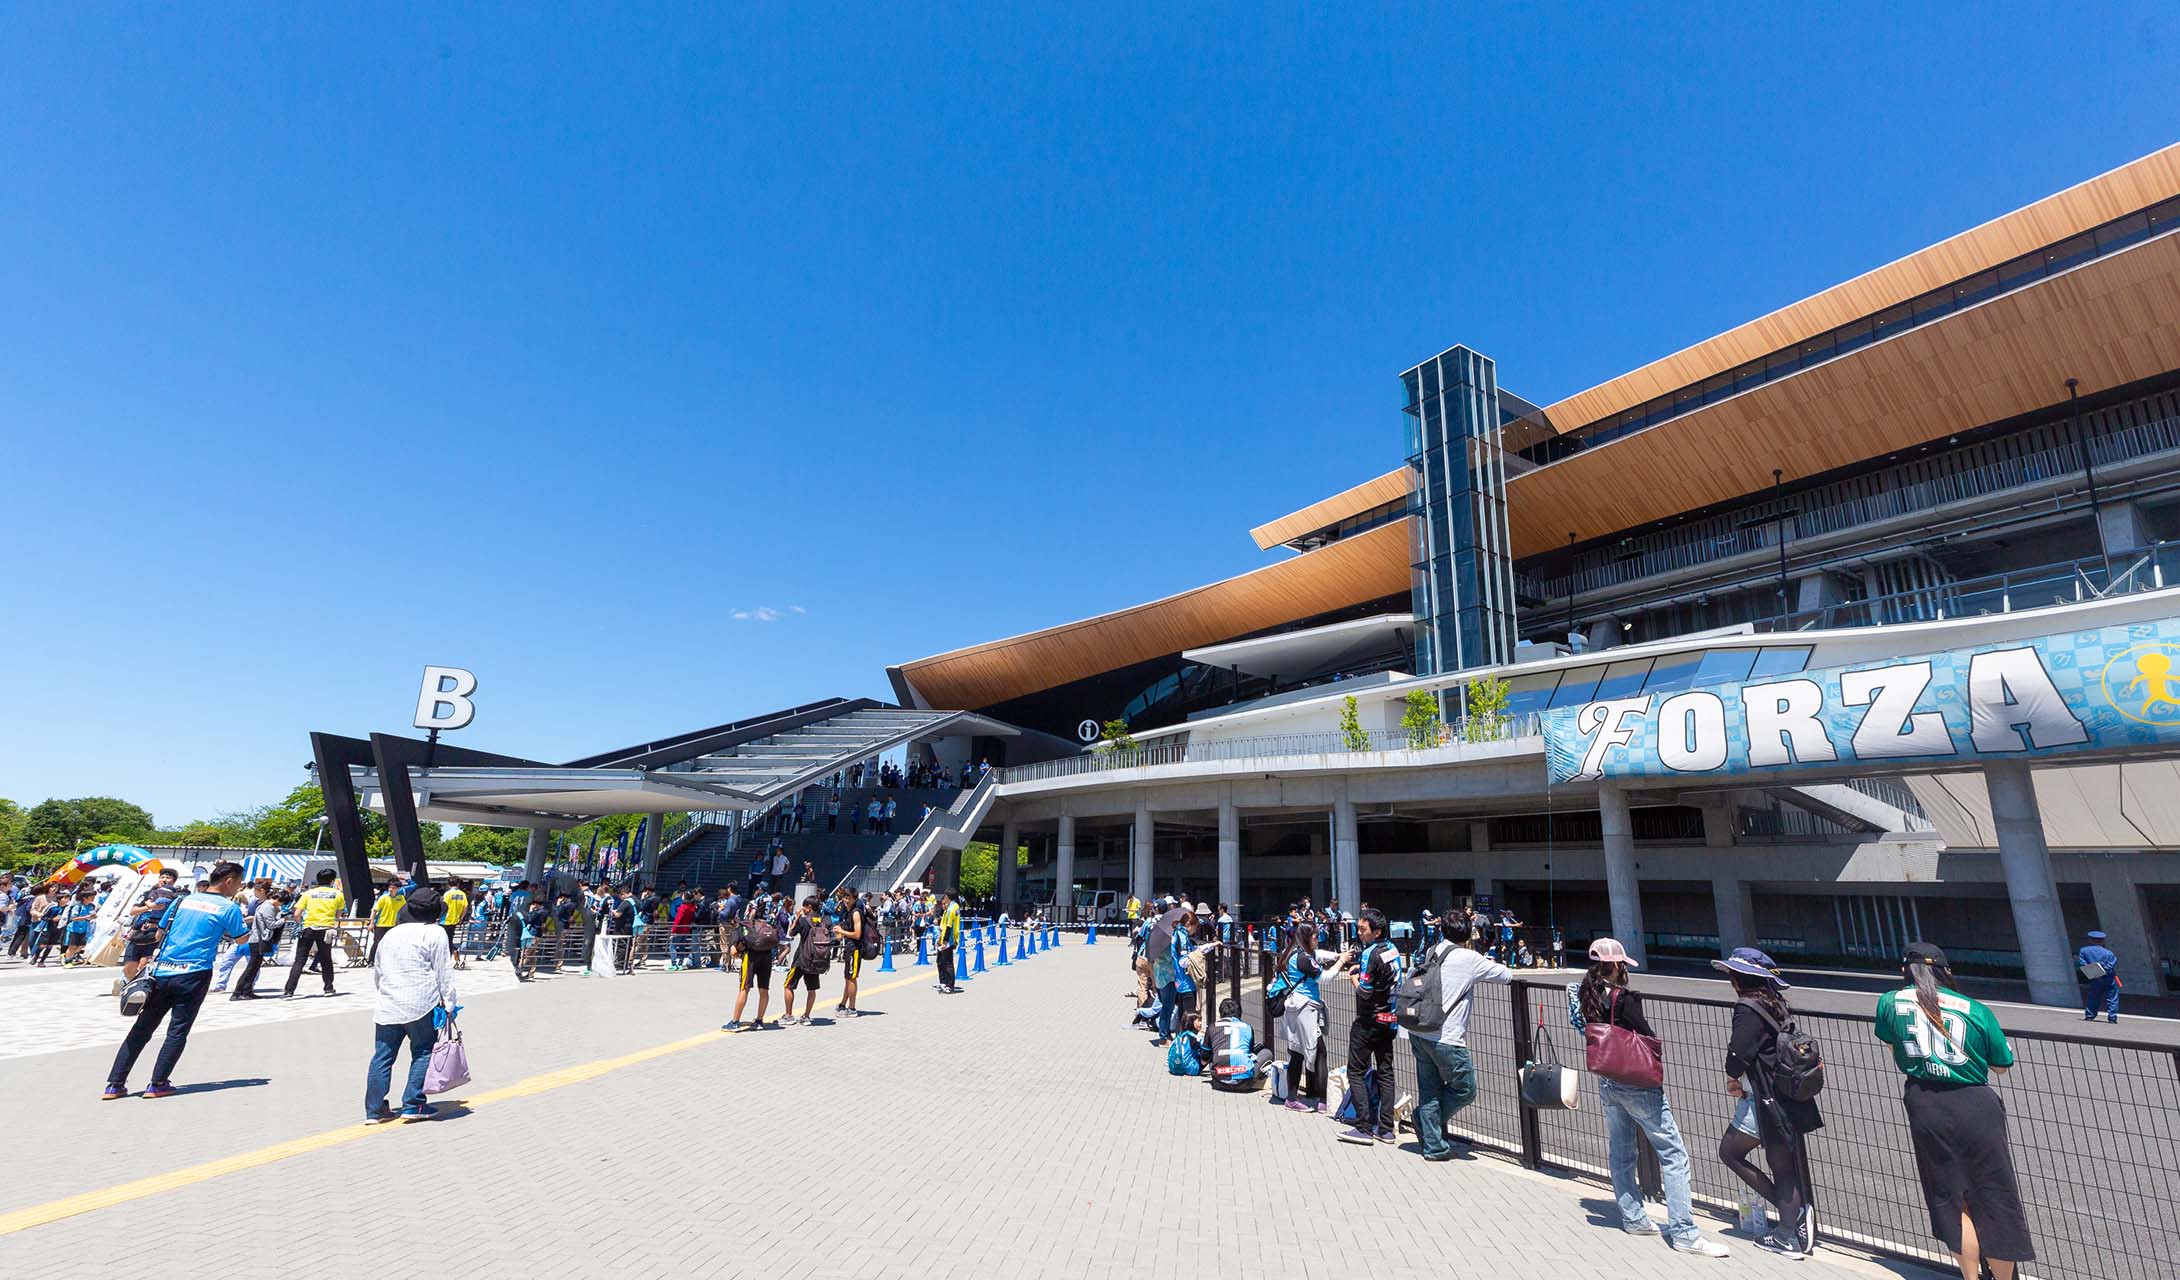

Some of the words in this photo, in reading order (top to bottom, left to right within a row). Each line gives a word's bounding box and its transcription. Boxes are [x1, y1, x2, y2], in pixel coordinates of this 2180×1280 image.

[413, 665, 478, 730] B
[1569, 645, 2091, 782] FORZA
[1895, 1001, 1968, 1065] 30
